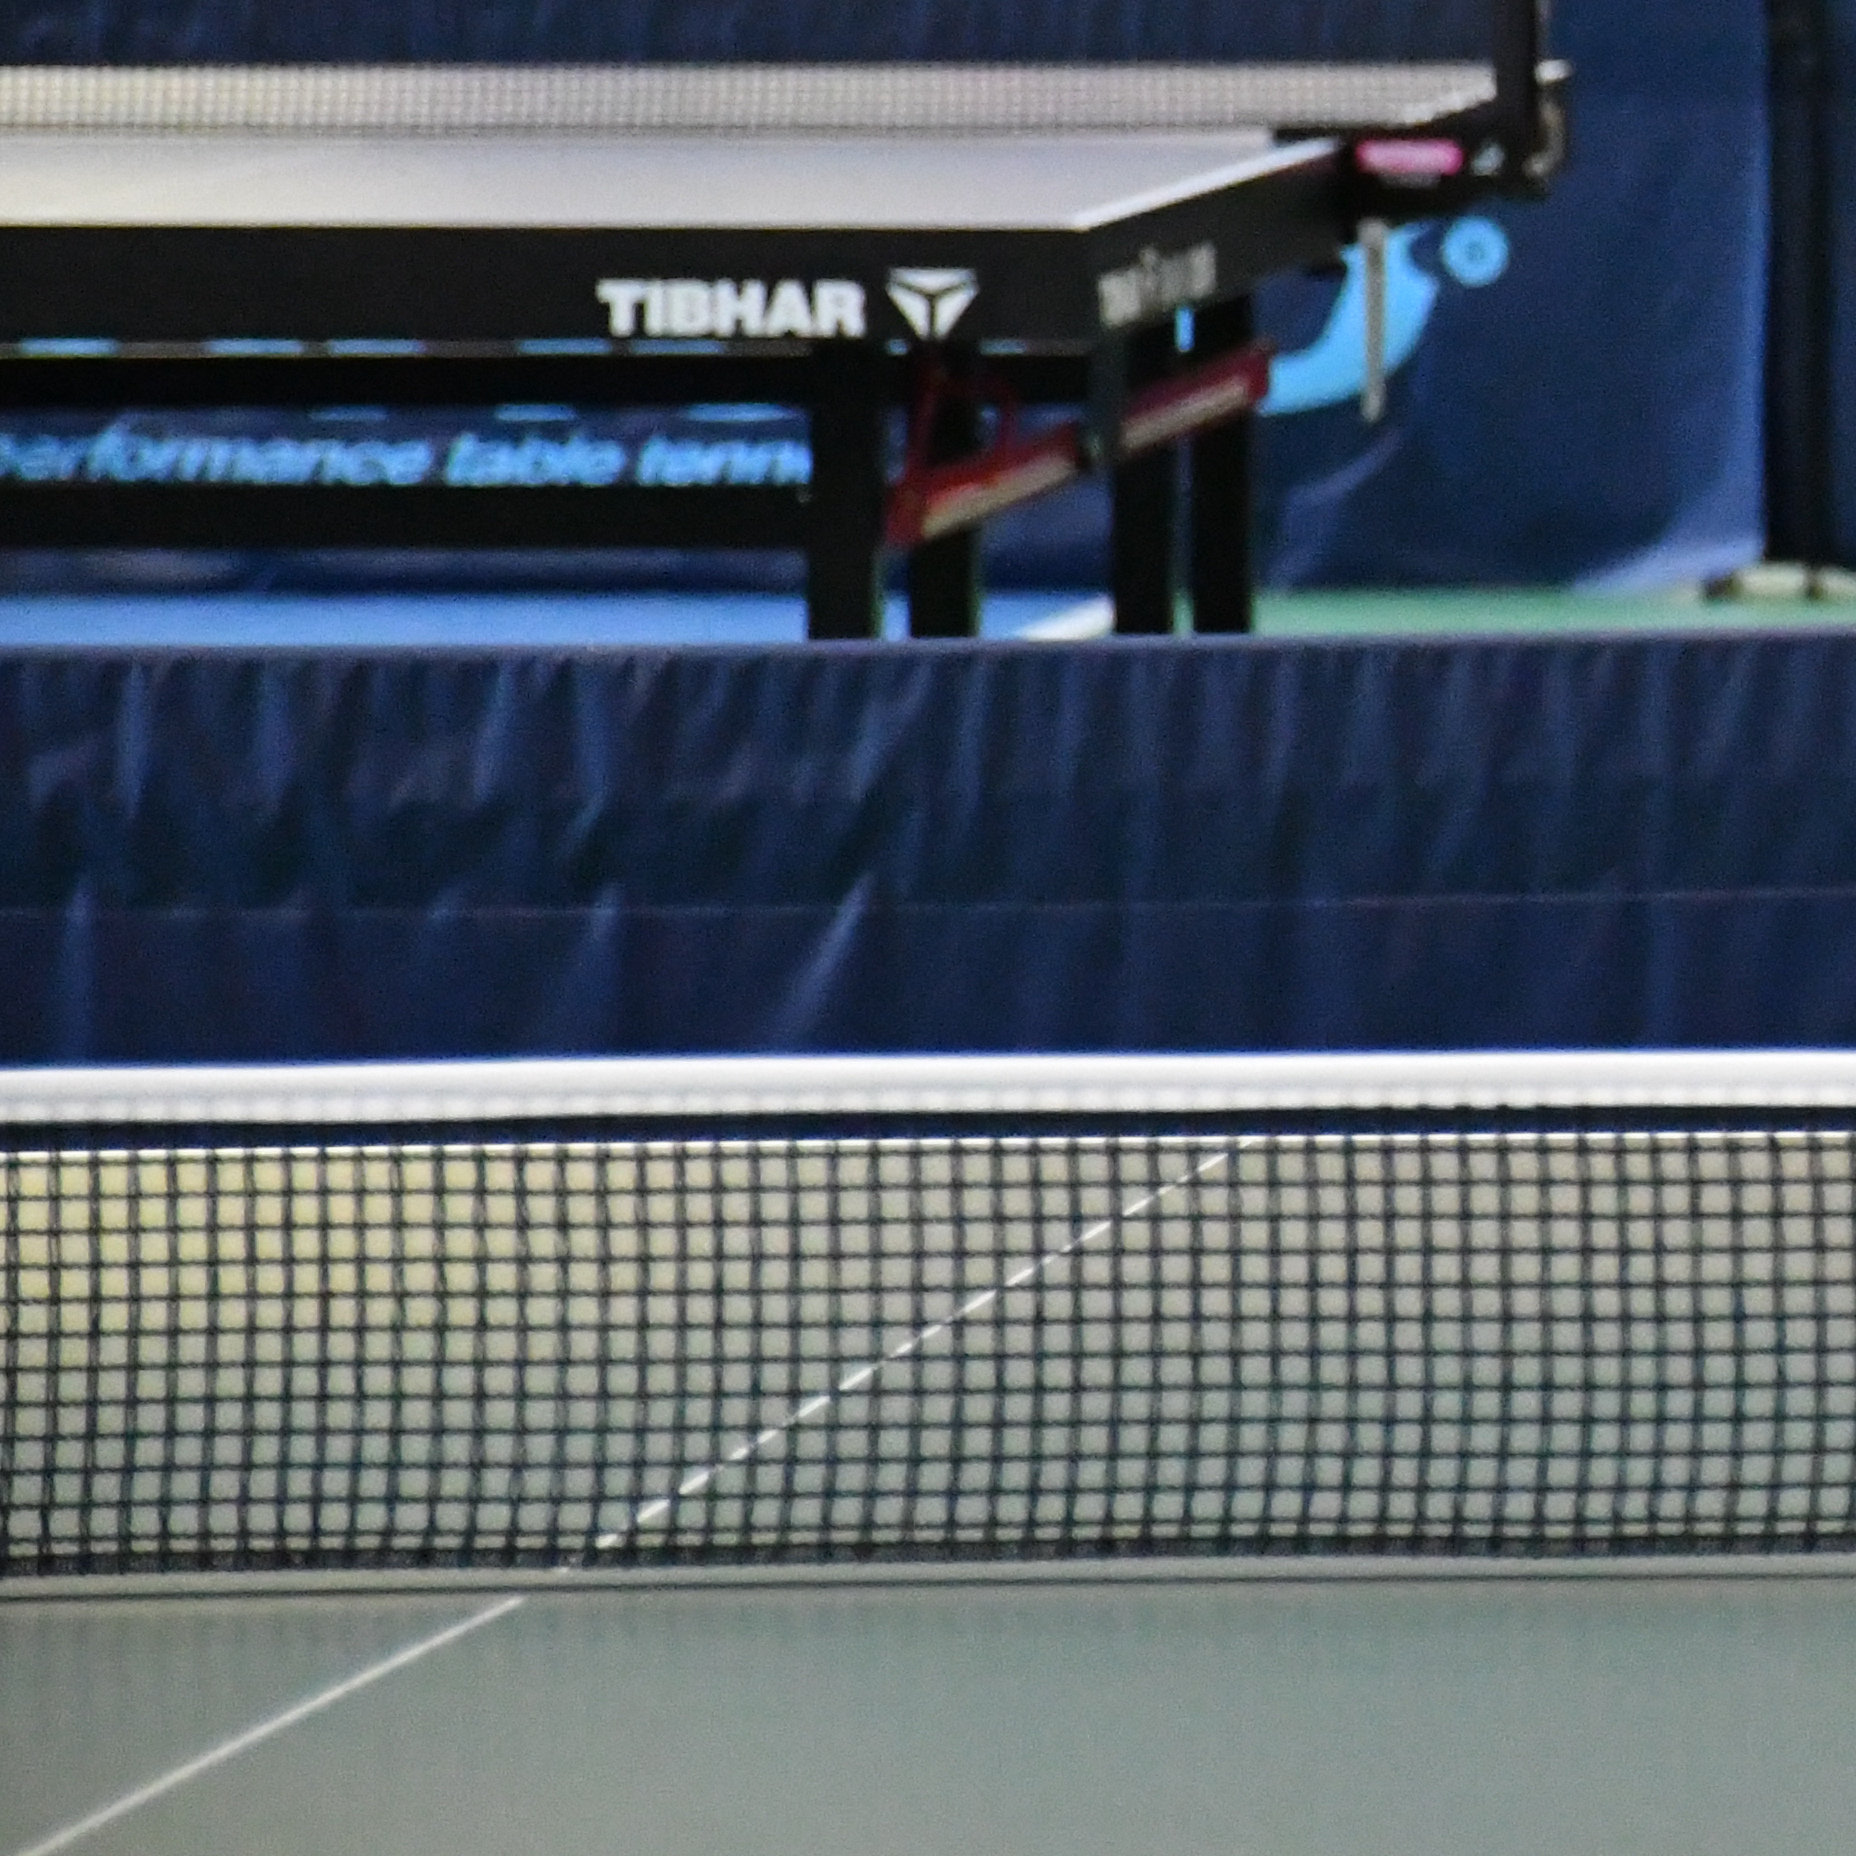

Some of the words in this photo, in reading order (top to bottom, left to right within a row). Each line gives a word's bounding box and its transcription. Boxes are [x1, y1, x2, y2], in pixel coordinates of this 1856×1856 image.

[595, 277, 867, 339] TIBHAR
[0, 417, 434, 484] erformance
[445, 430, 629, 486] table
